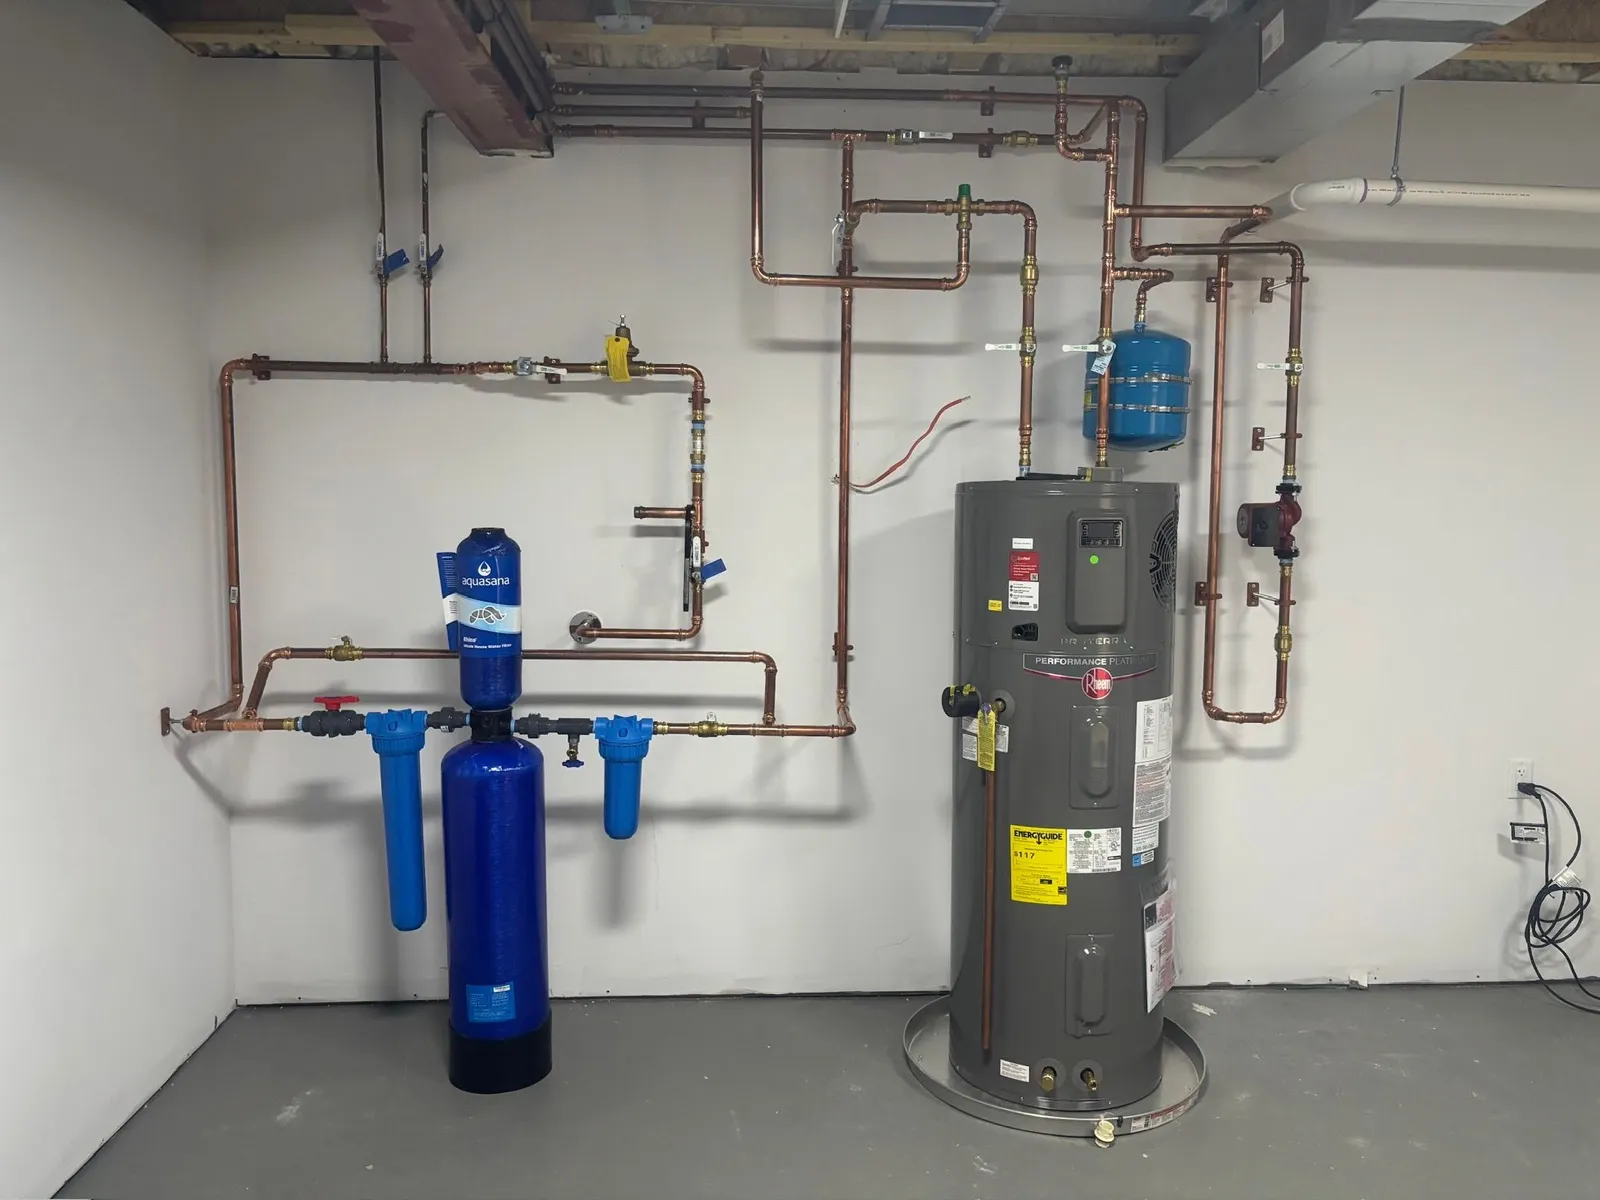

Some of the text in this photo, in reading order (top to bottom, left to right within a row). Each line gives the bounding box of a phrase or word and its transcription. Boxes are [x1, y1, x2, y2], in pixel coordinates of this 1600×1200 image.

[462, 577, 510, 589] aquasana
[1035, 656, 1149, 666] PERFORMANCE PLATI
[1086, 668, 1111, 694] Rheem
[1014, 830, 1063, 840] ENERGYGUIDE
[1013, 851, 1035, 859] $117
